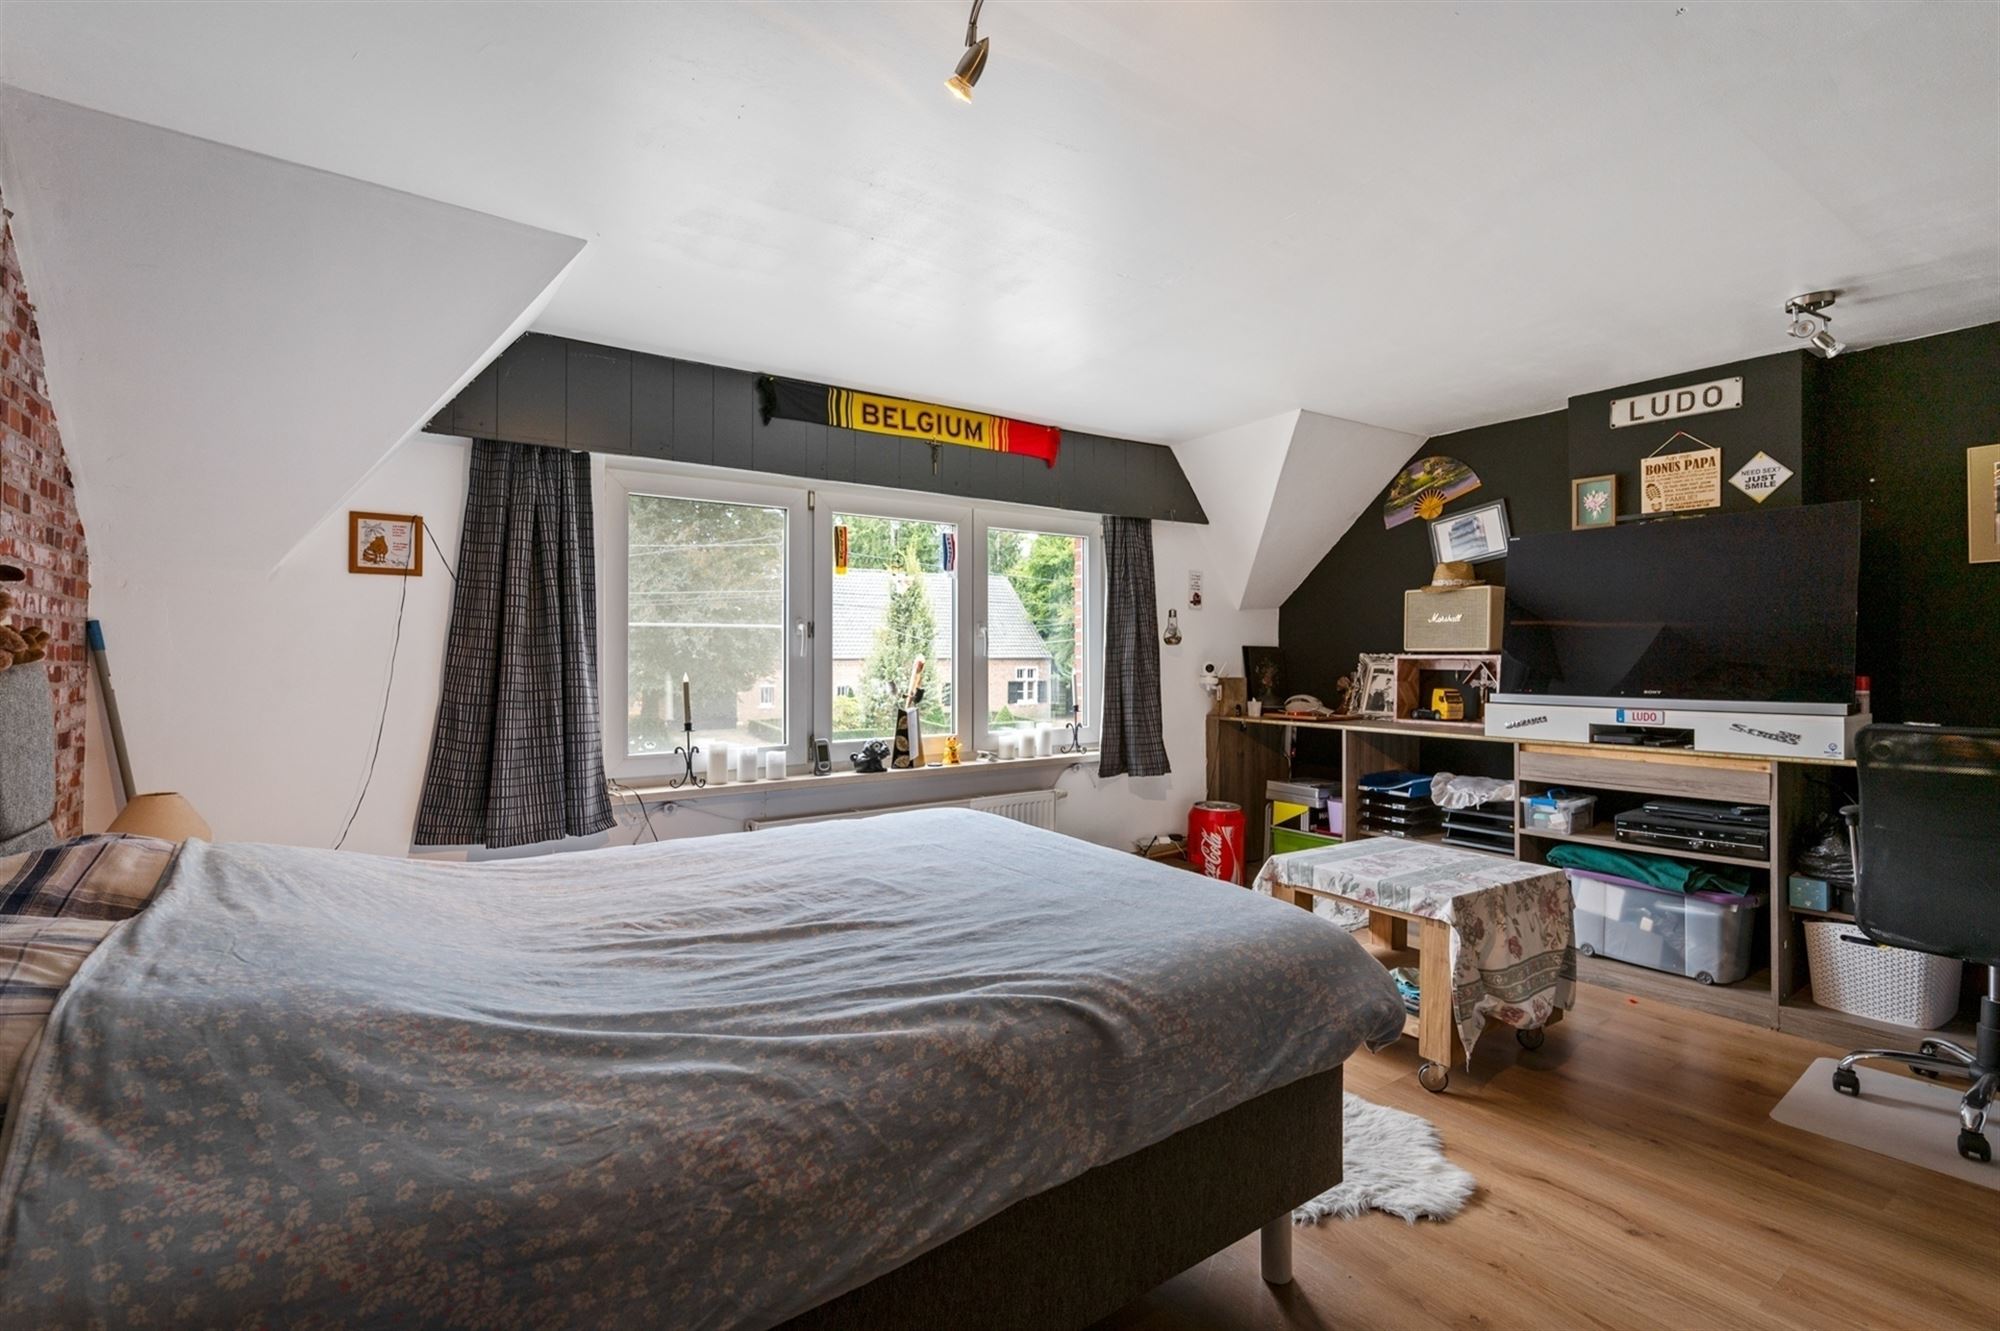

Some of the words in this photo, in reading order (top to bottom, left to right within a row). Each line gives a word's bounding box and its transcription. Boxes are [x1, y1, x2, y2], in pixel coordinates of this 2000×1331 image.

[1629, 385, 1723, 421] LUDO
[861, 402, 984, 442] BELGIUM
[1645, 461, 1681, 476] BONUS
[1684, 456, 1716, 471] PAPA
[1744, 473, 1776, 484] JUST
[1744, 480, 1776, 490] SMILE
[1427, 612, 1463, 623] Marshall
[1632, 711, 1657, 722] LUDO
